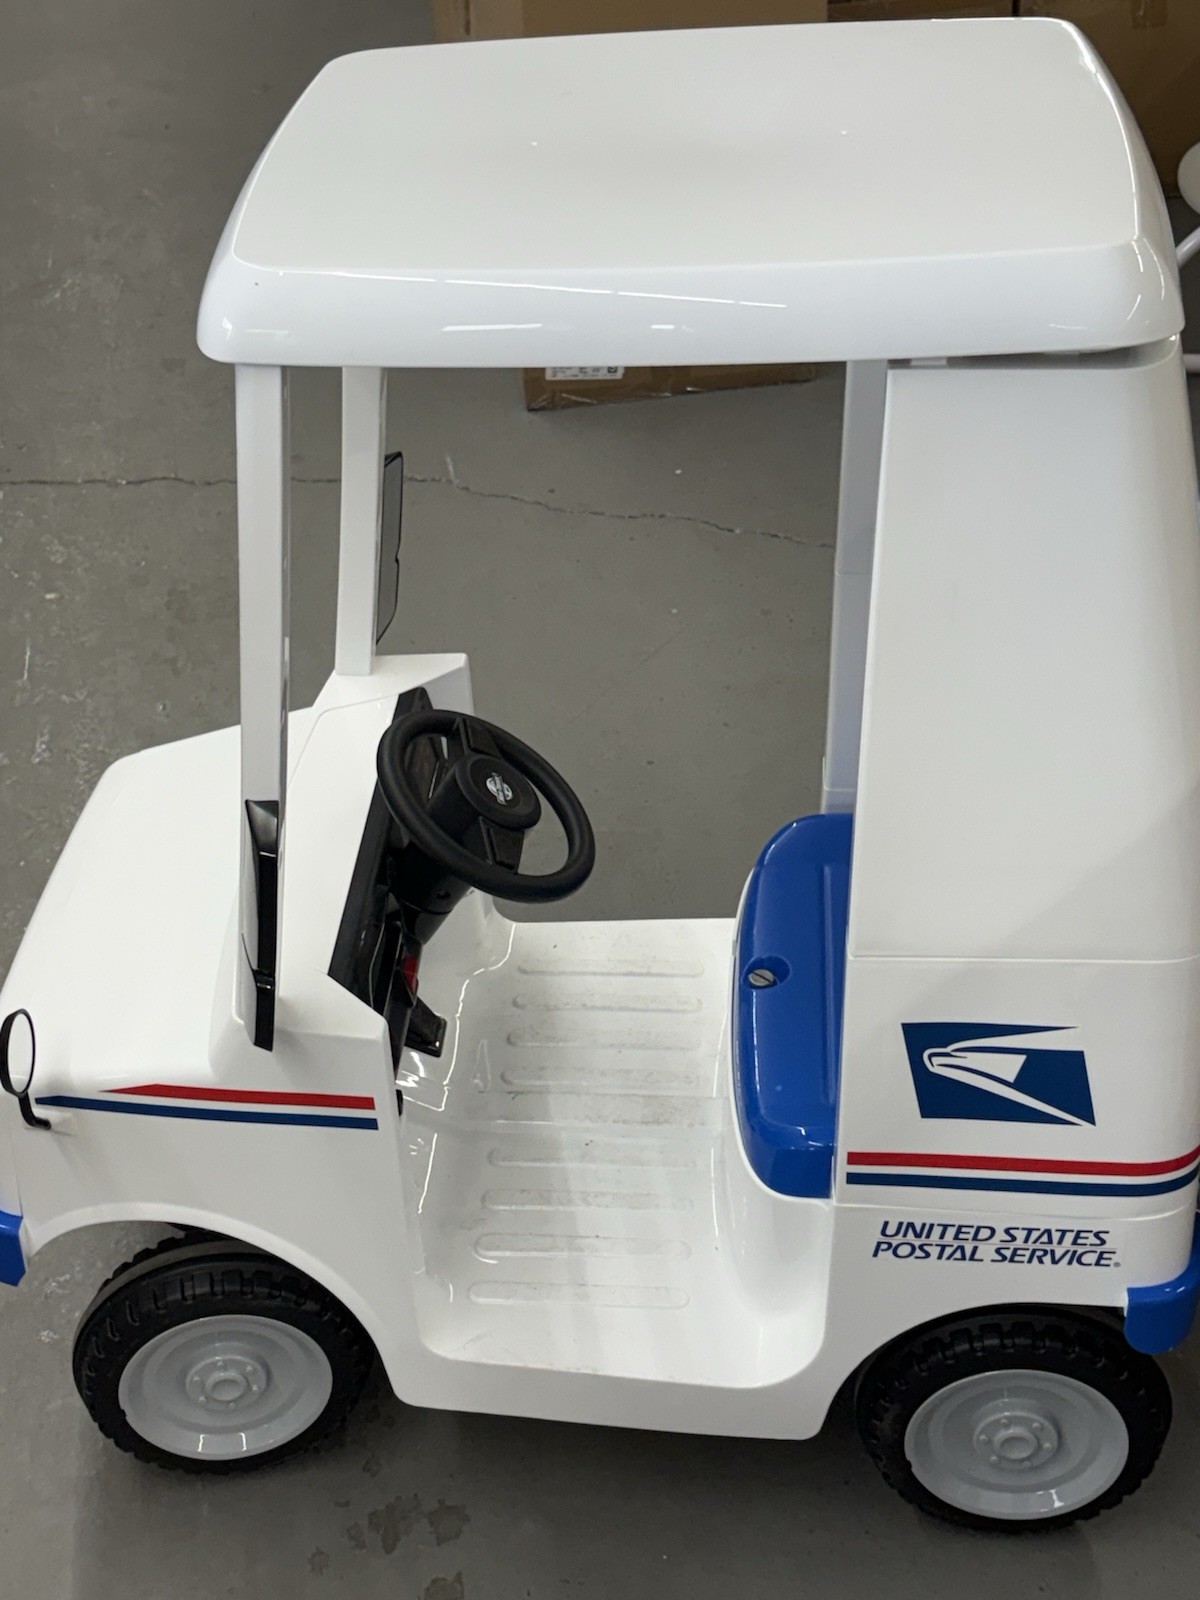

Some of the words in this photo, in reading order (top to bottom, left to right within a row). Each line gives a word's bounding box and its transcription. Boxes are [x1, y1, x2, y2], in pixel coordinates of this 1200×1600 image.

[880, 1220, 996, 1243] UNITED
[999, 1226, 1110, 1247] STATES
[872, 1241, 984, 1262] POSTAL
